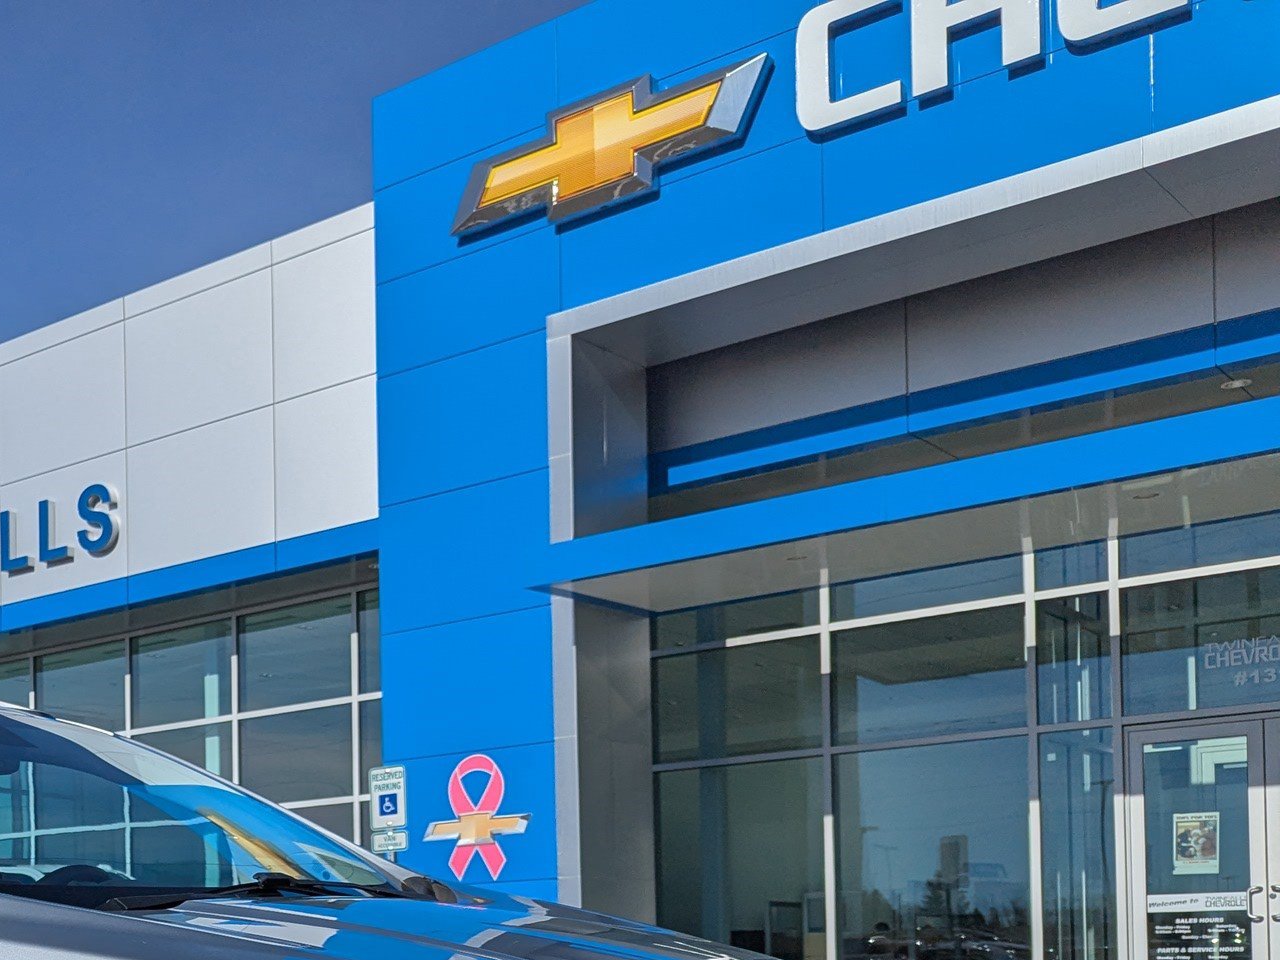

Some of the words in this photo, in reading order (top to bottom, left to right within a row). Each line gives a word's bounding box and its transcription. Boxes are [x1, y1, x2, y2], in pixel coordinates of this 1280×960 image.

[1234, 668, 1280, 686] #13
[372, 771, 403, 782] RESERVED
[373, 783, 402, 792] PARKING
[1149, 900, 1188, 908] Welcome
[1205, 899, 1247, 907] CHEVROLE
